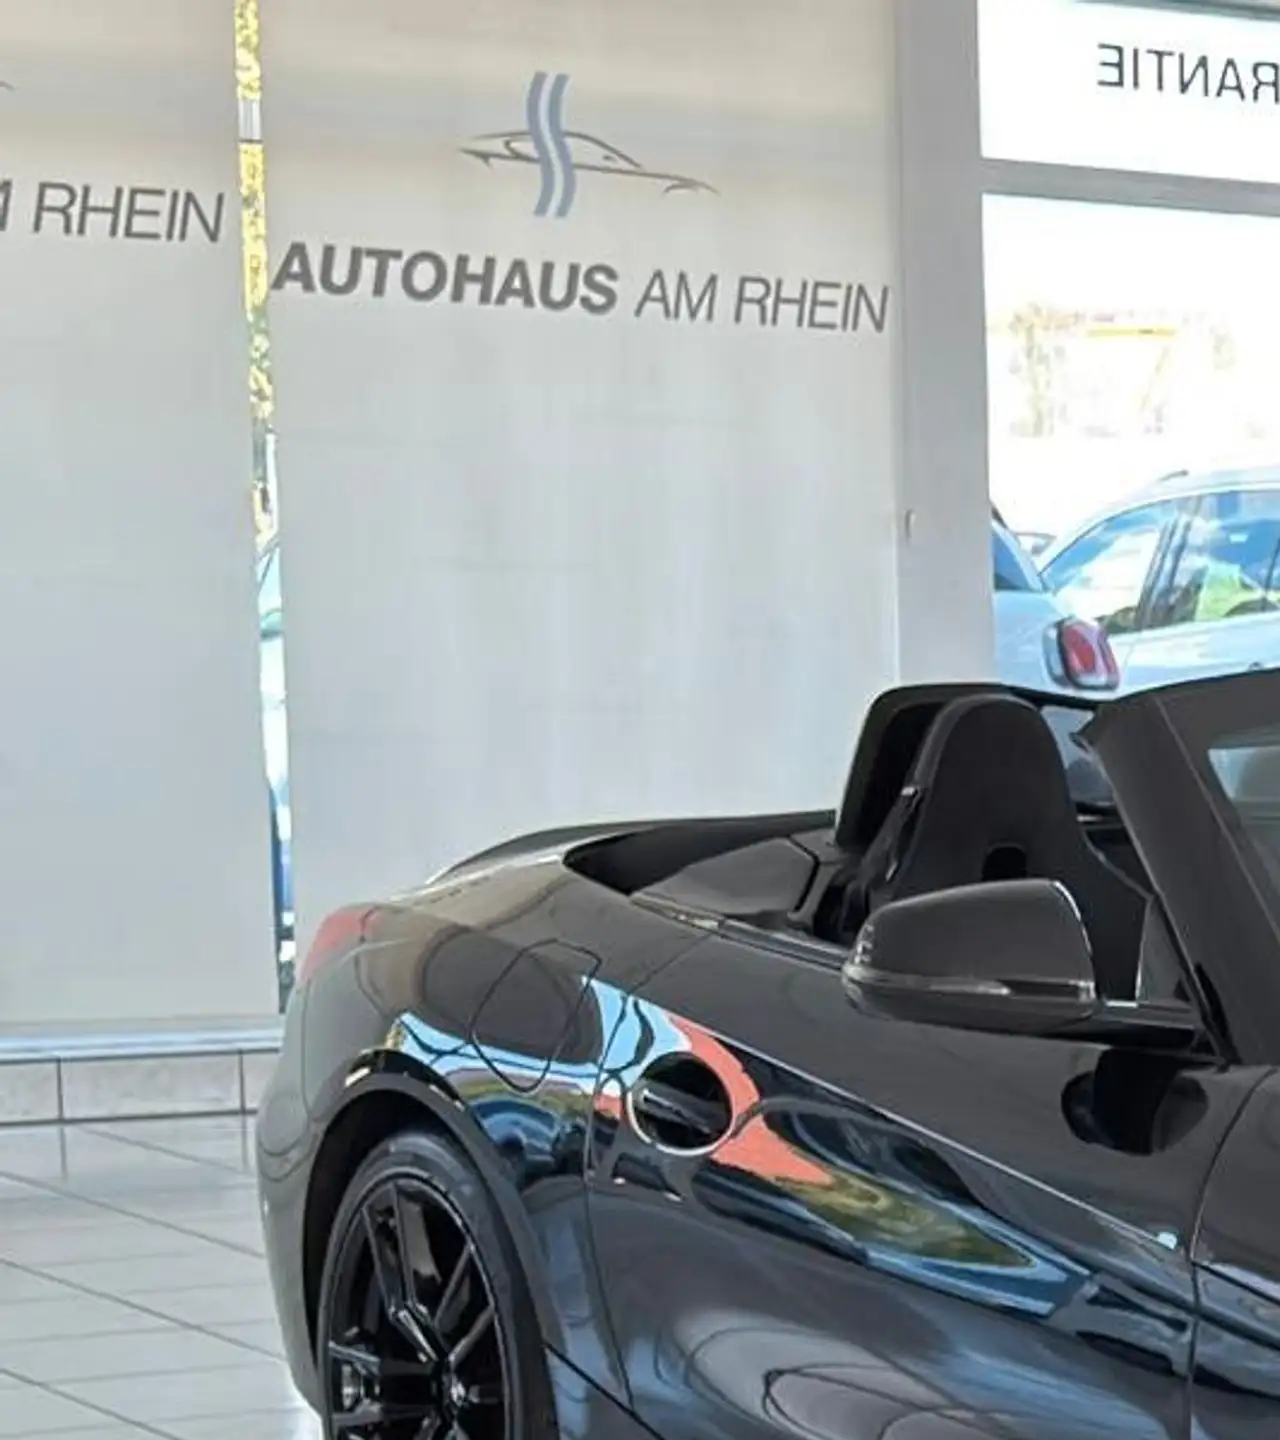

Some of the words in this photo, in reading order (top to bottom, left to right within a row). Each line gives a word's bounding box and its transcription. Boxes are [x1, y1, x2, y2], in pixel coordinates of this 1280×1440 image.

[32, 180, 225, 243] RHEIN
[271, 242, 619, 315] AUTOHAUS
[633, 268, 718, 323] AM
[733, 275, 892, 333] RHEIN
